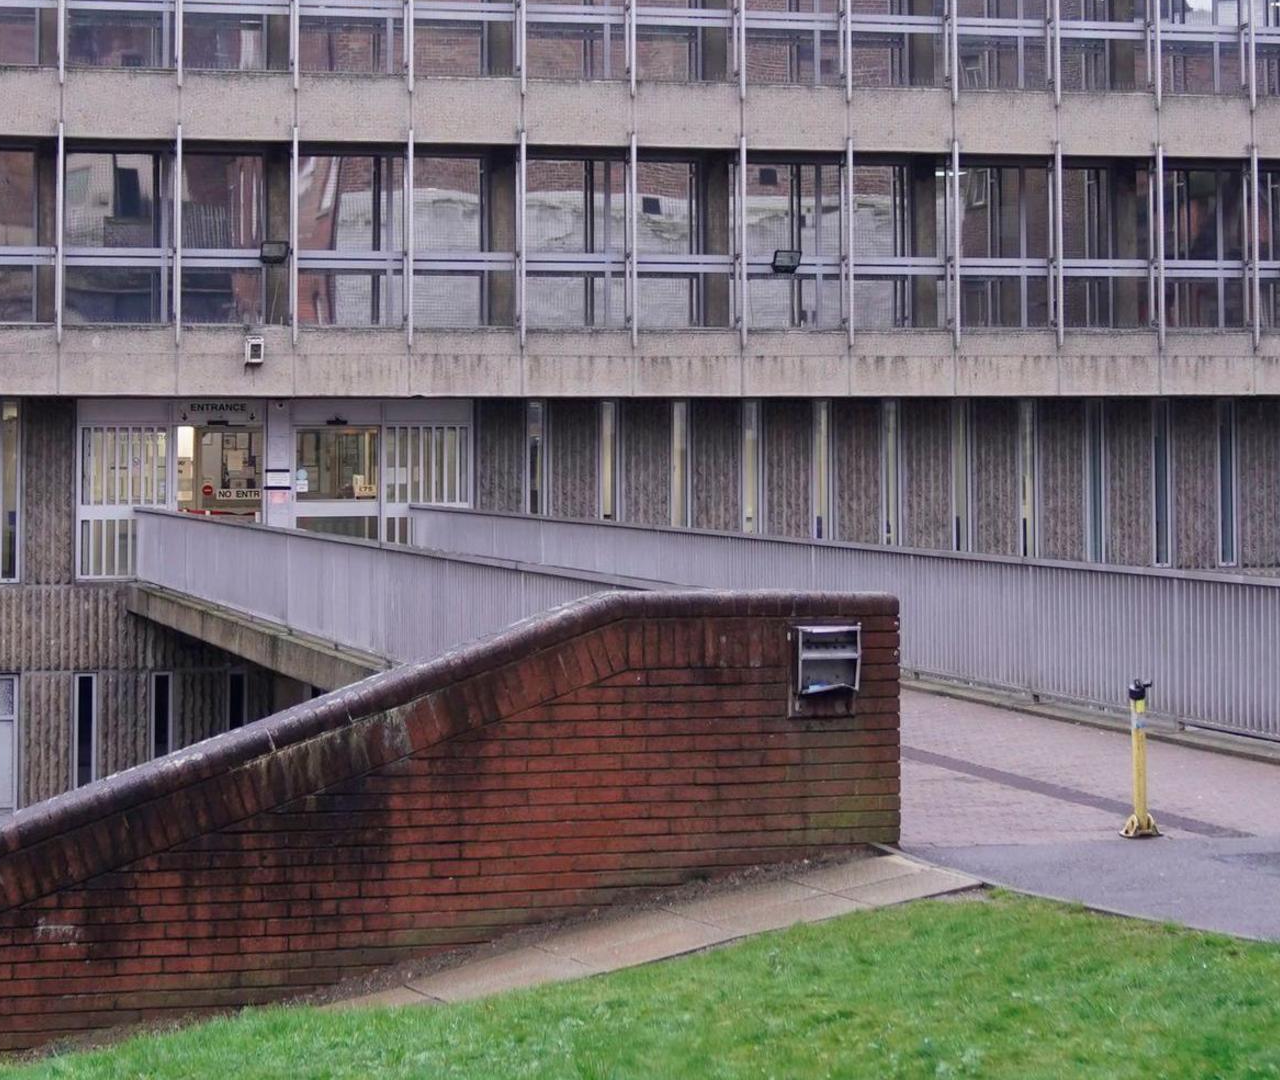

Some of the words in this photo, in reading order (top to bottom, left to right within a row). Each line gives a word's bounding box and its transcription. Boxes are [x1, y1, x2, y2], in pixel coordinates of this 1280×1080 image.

[190, 403, 247, 412] ENTRANCE
[218, 490, 231, 498] NO
[235, 490, 260, 498] ENTR
